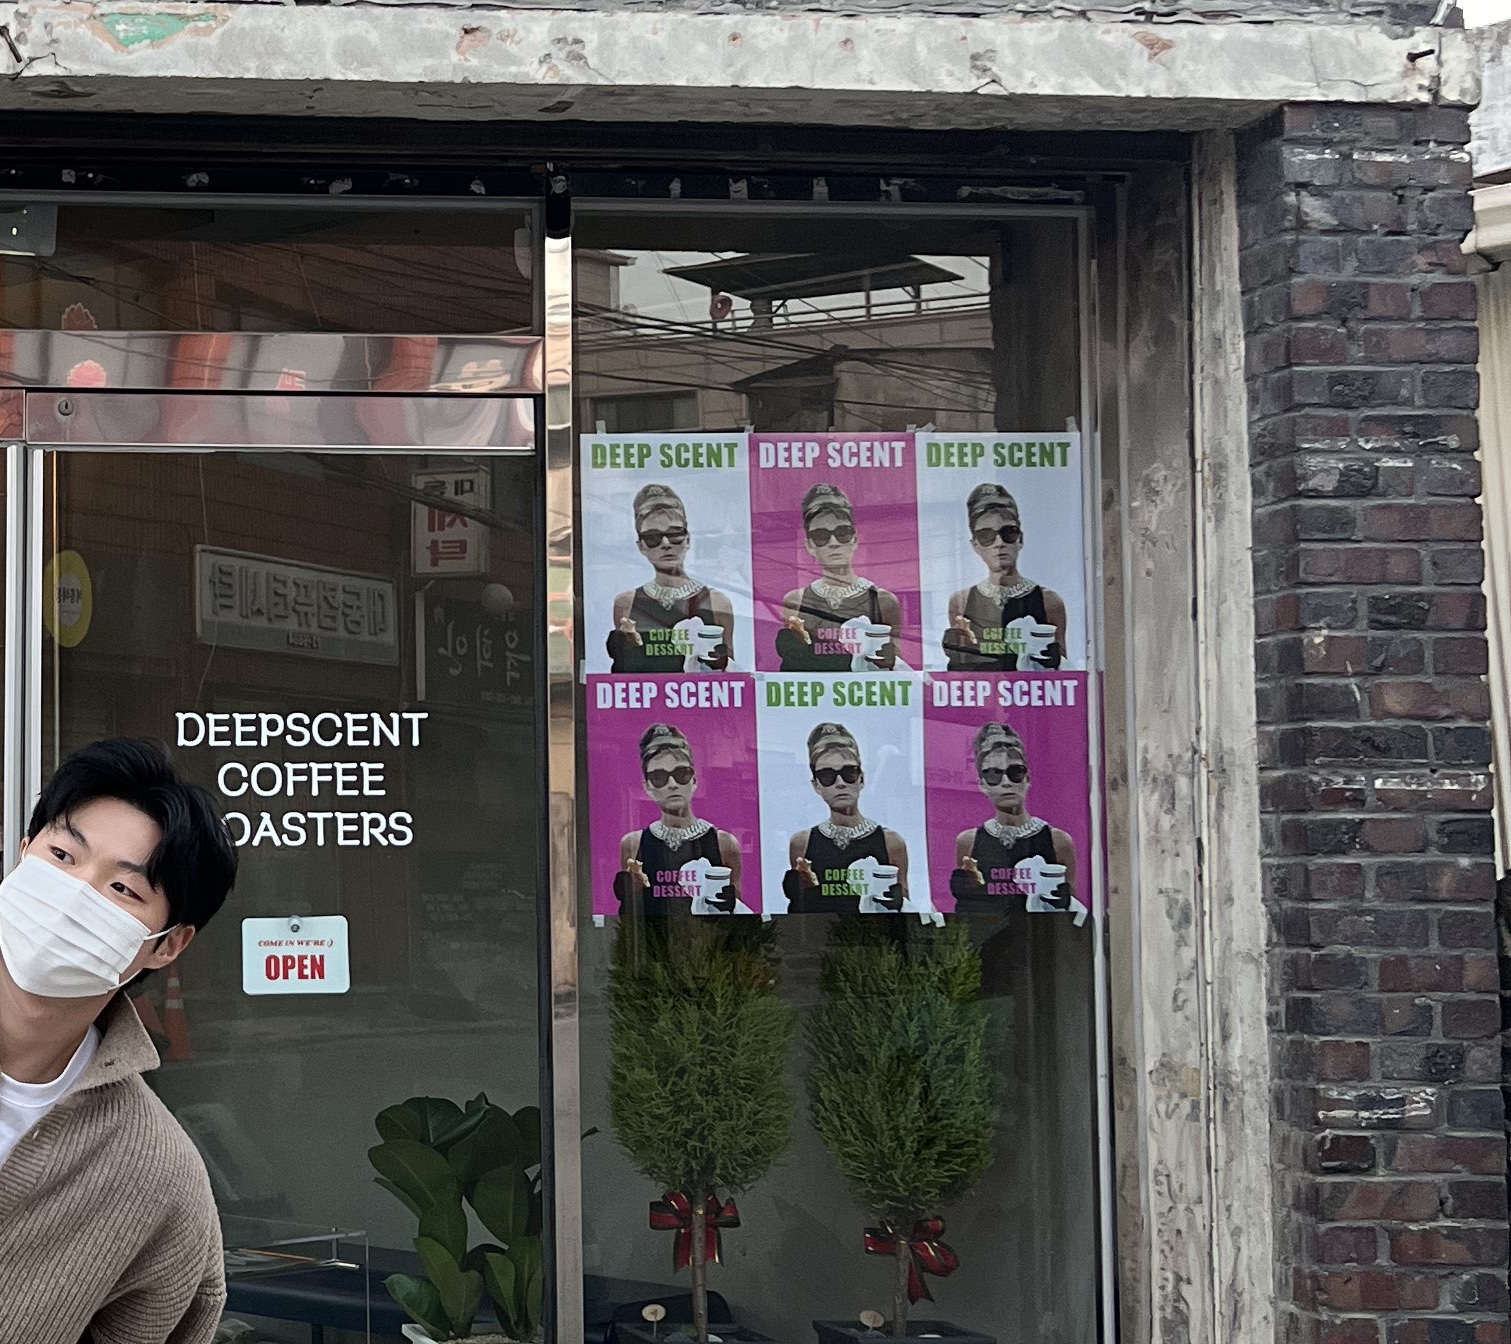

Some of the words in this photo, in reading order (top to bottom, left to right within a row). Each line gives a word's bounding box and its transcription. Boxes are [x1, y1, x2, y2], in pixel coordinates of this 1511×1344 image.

[591, 443, 652, 469] DEEP
[659, 442, 738, 469] SCENT
[759, 442, 820, 469] DEEP
[827, 442, 906, 468] SCENT
[926, 442, 984, 468] DEEP
[992, 441, 1071, 468] SCENT
[649, 628, 689, 642] COFFEE
[817, 627, 857, 641] COFFEE
[596, 682, 658, 709] DEEP
[664, 681, 745, 708] SCENT
[766, 681, 825, 707] DEEP
[832, 680, 913, 707] SCENT
[932, 680, 991, 707] DEEP
[997, 679, 1078, 706] SCENT
[175, 711, 429, 747] DEEPSCENT
[217, 761, 386, 797] COFFEE
[221, 811, 414, 847] OASTERS
[656, 869, 697, 883] COFFEE
[825, 868, 864, 882] COFFEE
[265, 954, 325, 980] OPEN
